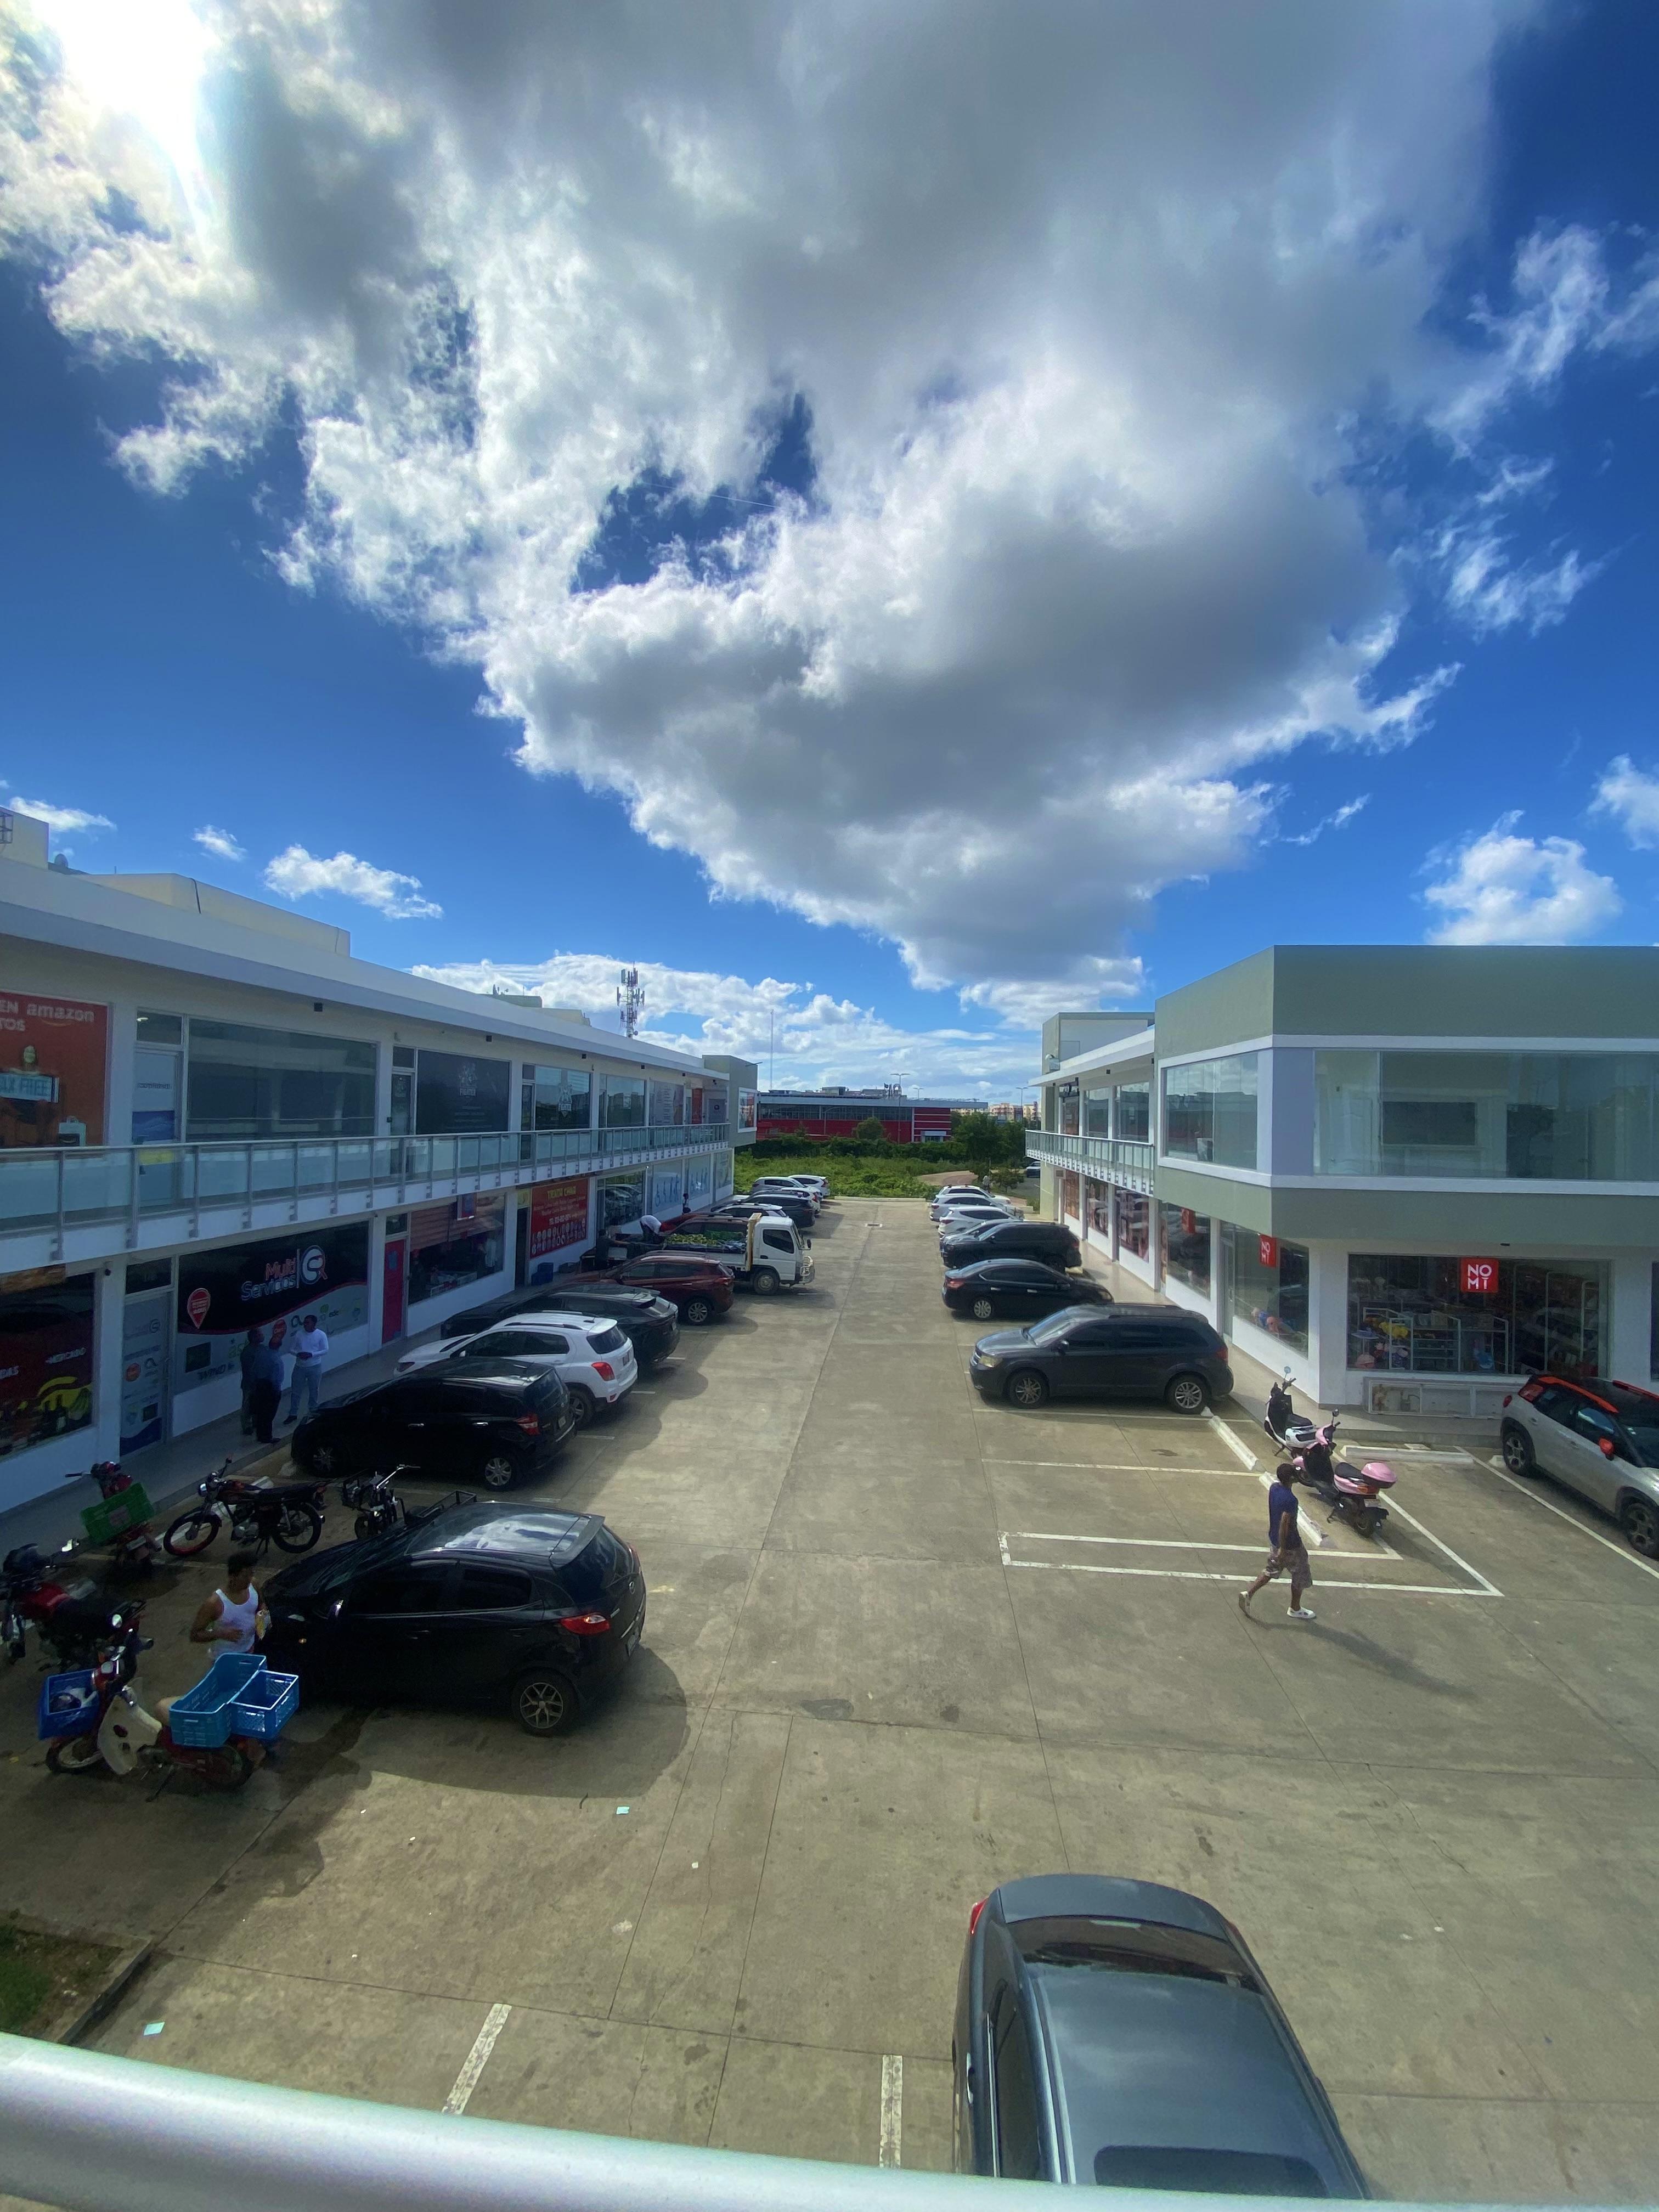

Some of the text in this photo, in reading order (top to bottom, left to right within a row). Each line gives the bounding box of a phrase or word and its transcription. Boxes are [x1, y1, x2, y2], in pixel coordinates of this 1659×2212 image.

[27, 1004, 94, 1023] amazon
[266, 1257, 297, 1281] Multi
[1468, 1264, 1492, 1277] NO
